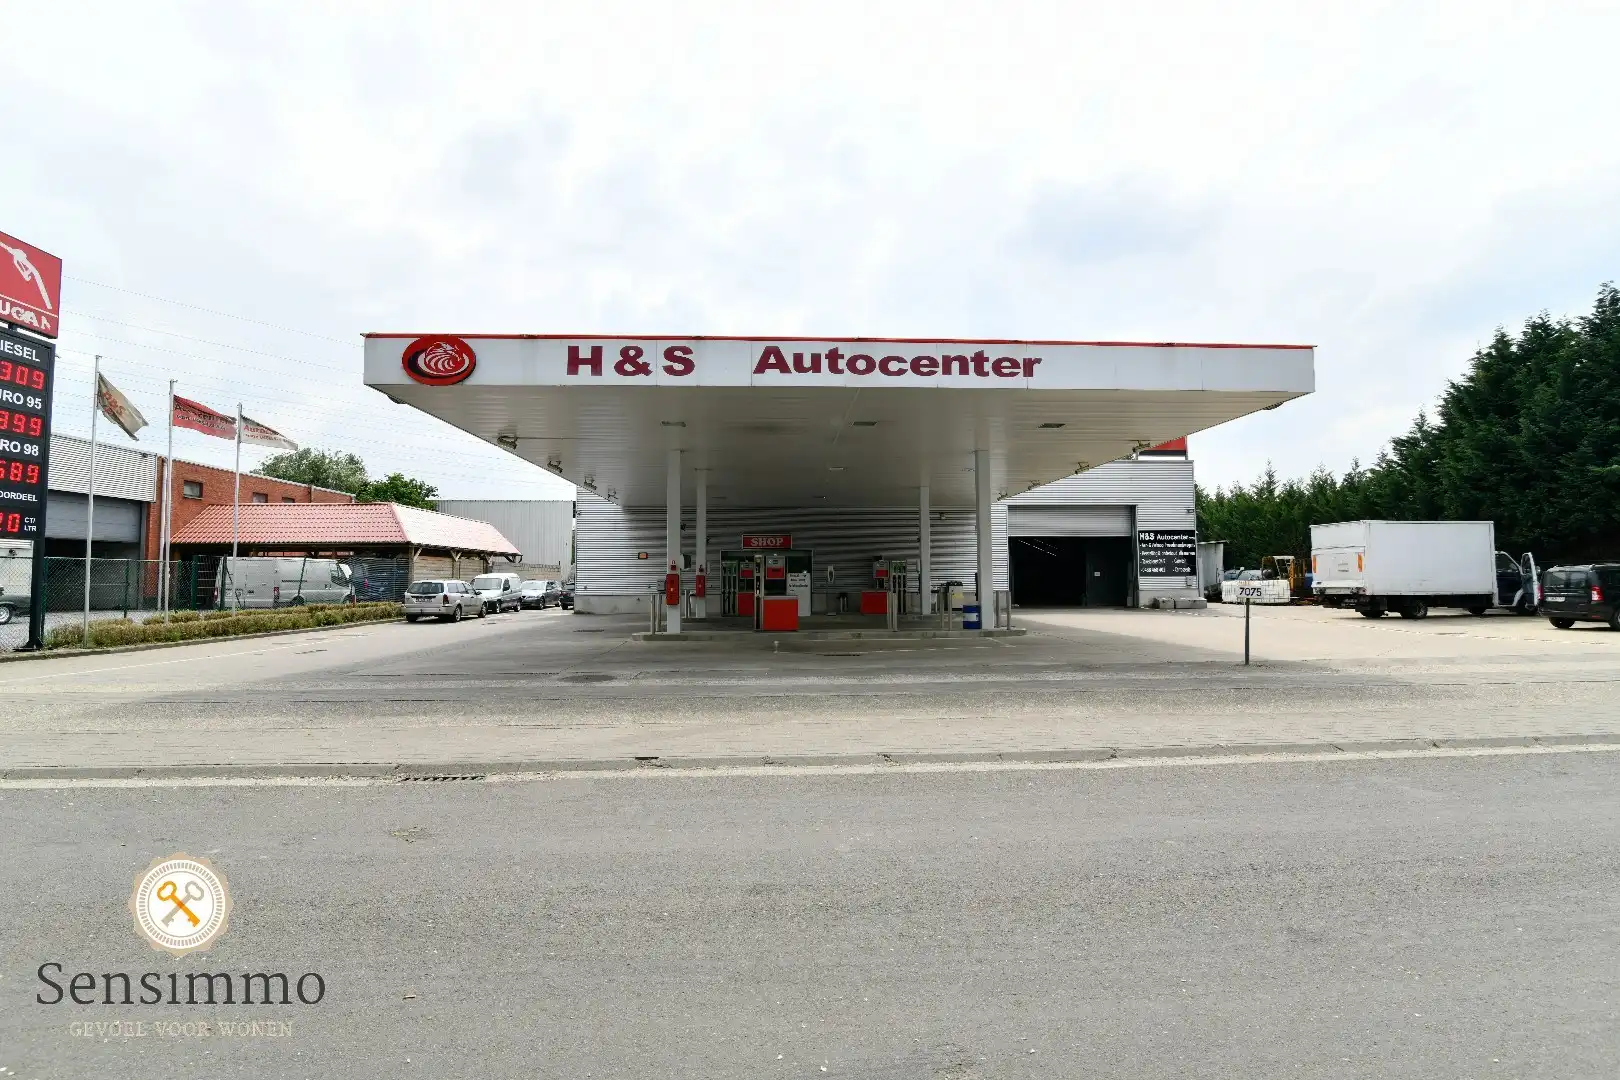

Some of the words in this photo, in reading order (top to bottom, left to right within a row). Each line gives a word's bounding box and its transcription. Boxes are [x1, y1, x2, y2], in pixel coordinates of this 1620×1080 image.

[752, 345, 1043, 378] Autocenter
[0, 388, 24, 405] RO
[26, 395, 42, 410] 95
[23, 443, 39, 457] 98
[750, 537, 784, 547] SHOP
[1239, 587, 1262, 597] 7075
